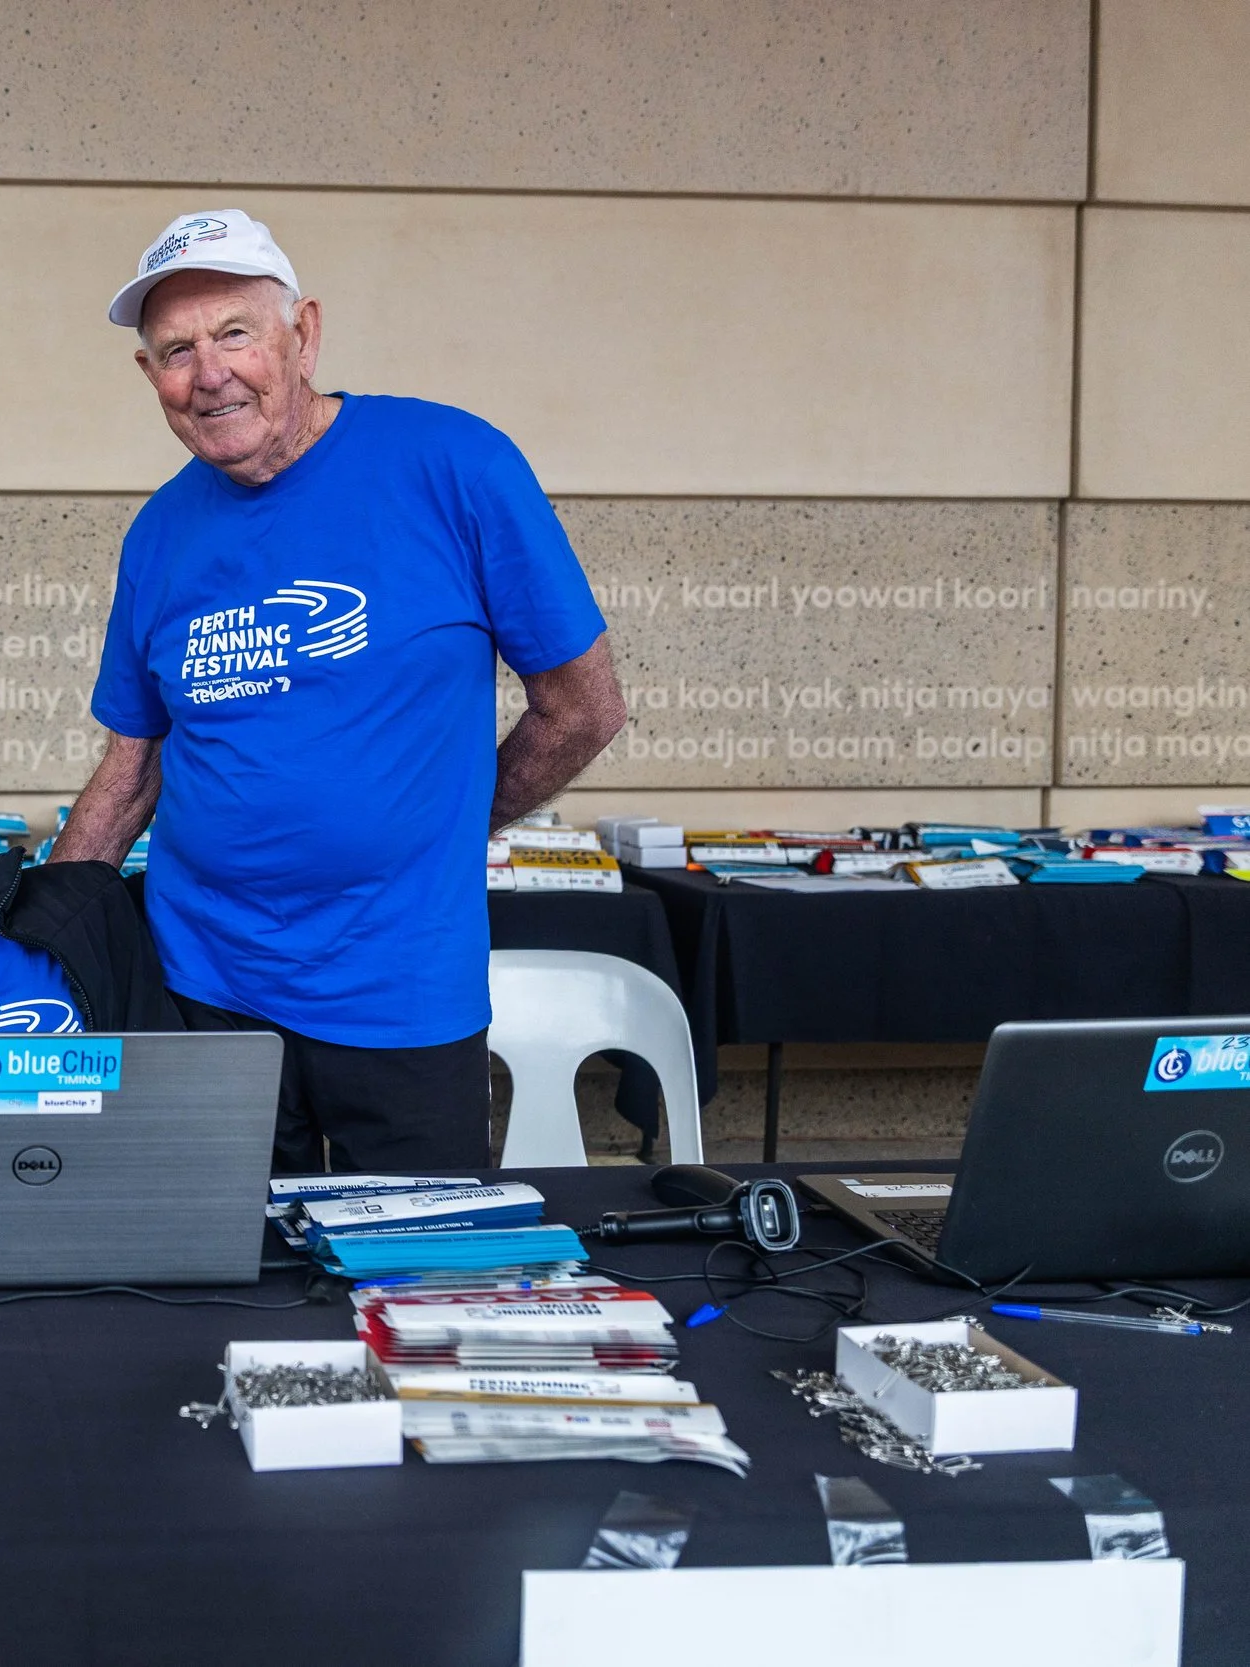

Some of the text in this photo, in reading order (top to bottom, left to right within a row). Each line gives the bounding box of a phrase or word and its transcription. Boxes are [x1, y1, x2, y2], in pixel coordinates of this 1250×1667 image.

[682, 577, 779, 609] kaarl
[791, 578, 942, 617] yoowarl
[954, 578, 1047, 609] koorl
[1071, 579, 1214, 617] naariny.
[189, 605, 255, 637] PERTH
[186, 623, 291, 658] RUNNING
[181, 647, 289, 679] FESTIVAL
[184, 678, 272, 704] telethon
[679, 678, 769, 710] koorl
[780, 678, 853, 718] yak,
[860, 679, 937, 716] nitja
[948, 686, 1049, 716] maya
[1072, 679, 1250, 716] waangkin
[627, 729, 776, 768] boodjar
[788, 729, 905, 762] baam,
[916, 729, 1046, 766] baalap
[1068, 730, 1146, 766] nitja
[1157, 735, 1250, 766] maya
[8, 1050, 117, 1077] blueChip
[1196, 1047, 1250, 1072] blue
[57, 1074, 102, 1085] TIMING
[44, 1099, 87, 1107] blueChip
[18, 1160, 57, 1171] DELL
[1170, 1148, 1214, 1165] DELL
[431, 1194, 473, 1202] RUNNING
[460, 1186, 503, 1195] FESTIVAL
[474, 1192, 505, 1200] PERTH
[493, 1308, 556, 1316] RUNNING
[470, 1379, 590, 1390] PERTH RUNNING
